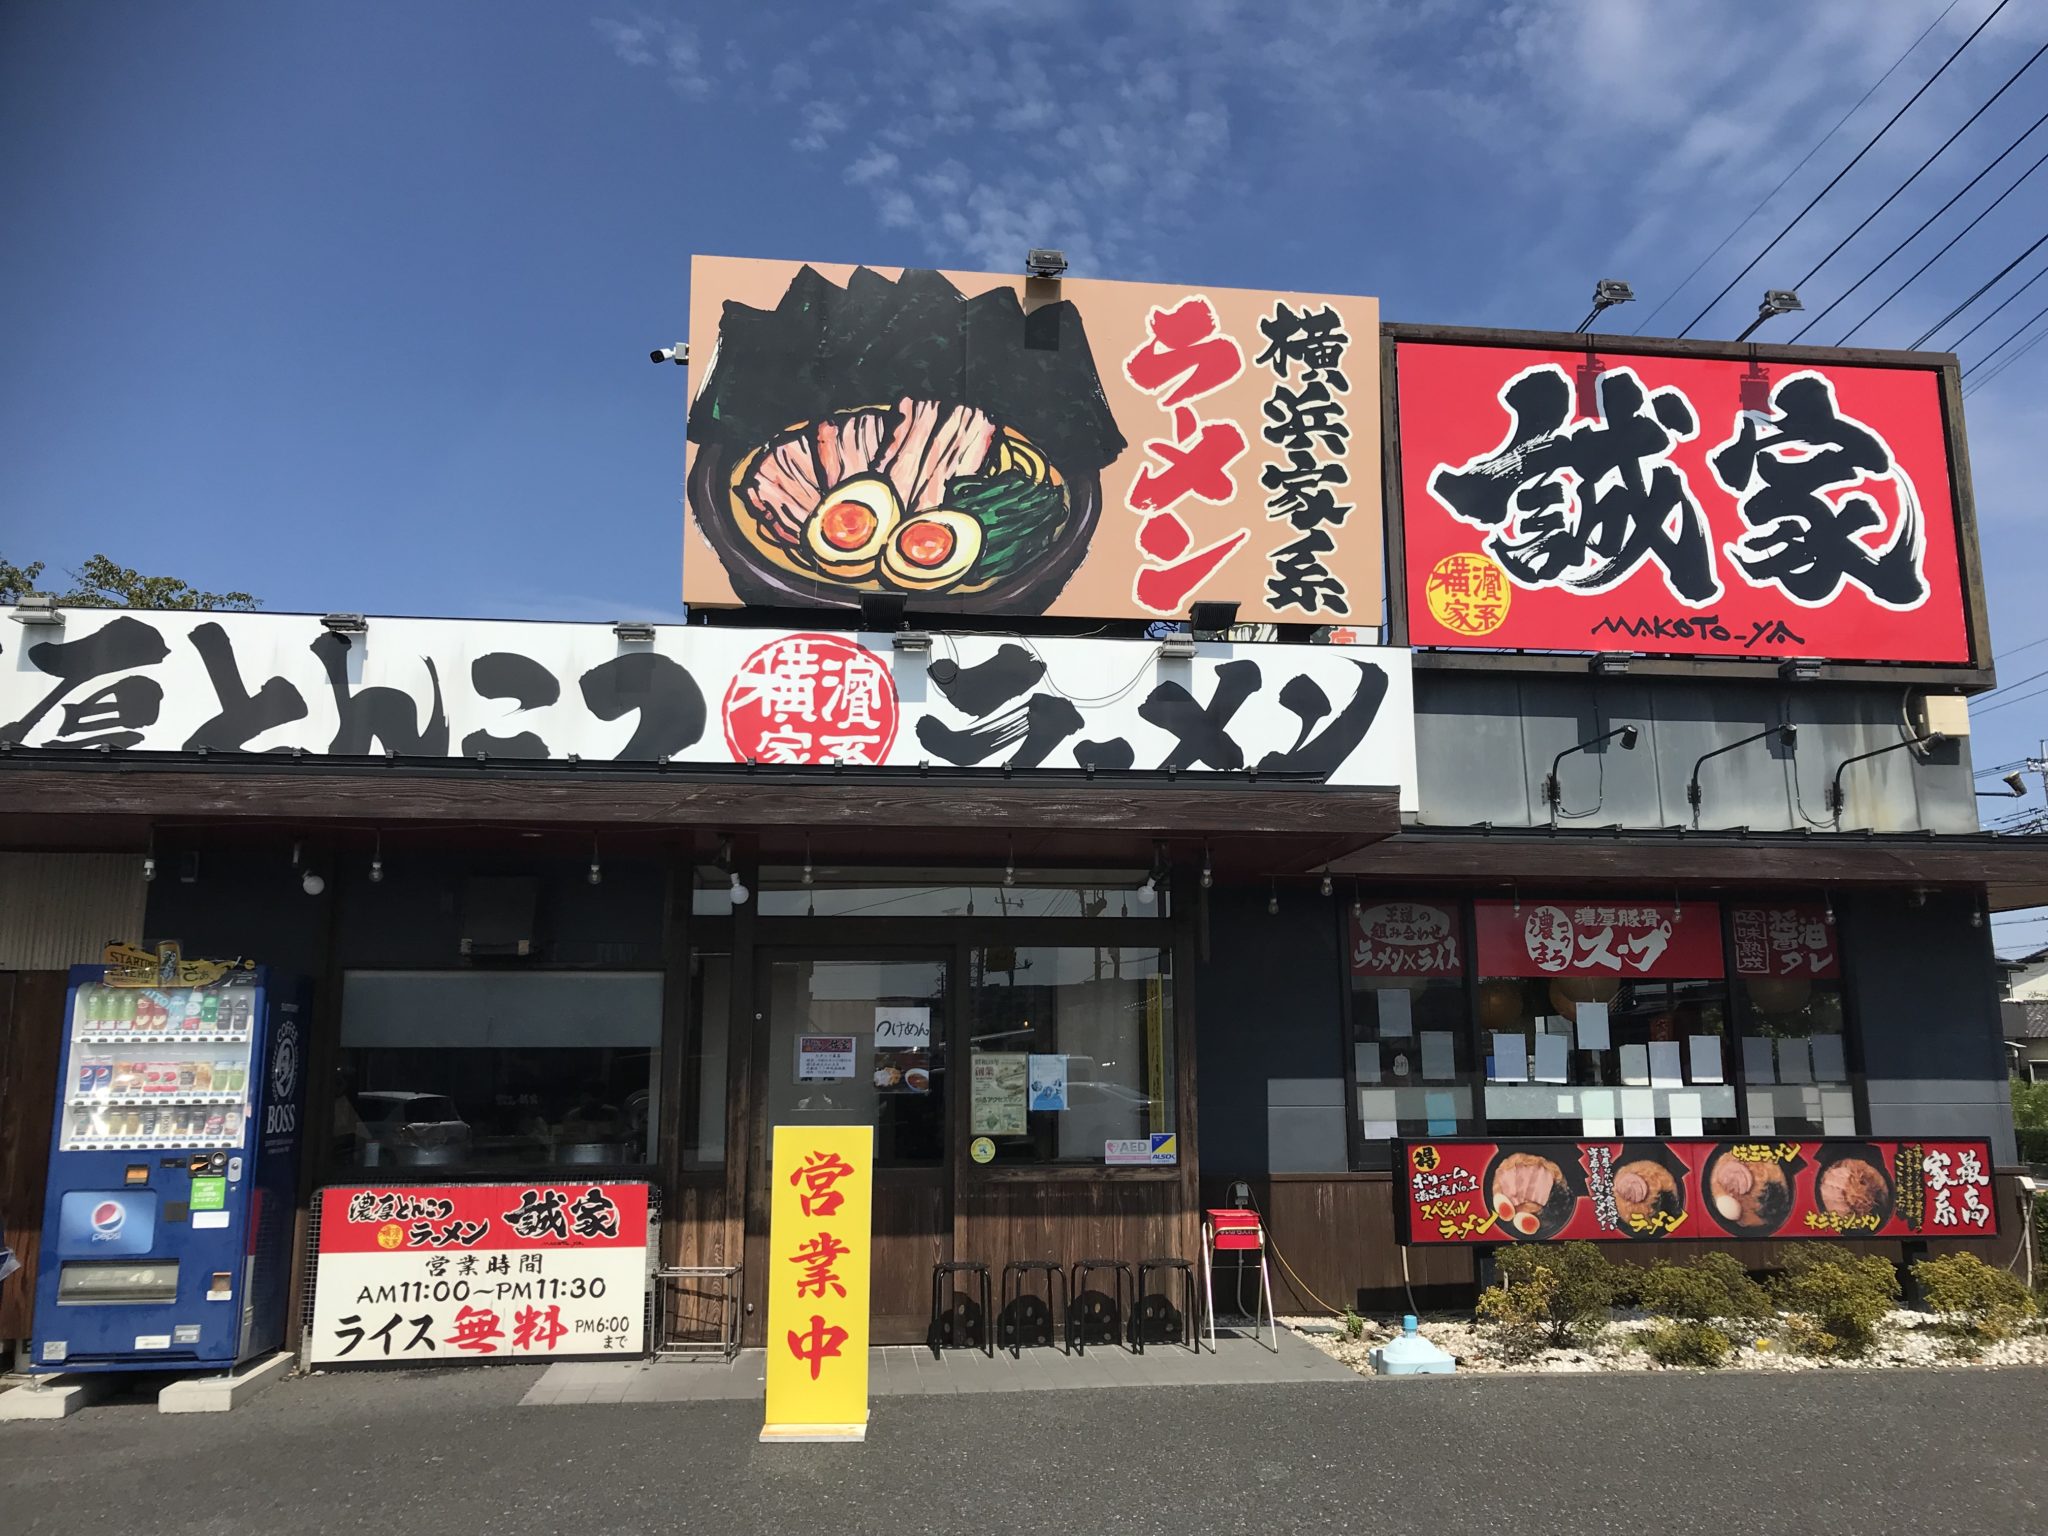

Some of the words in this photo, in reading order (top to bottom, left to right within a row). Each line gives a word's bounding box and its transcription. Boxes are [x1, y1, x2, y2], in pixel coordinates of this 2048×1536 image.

[1126, 297, 1249, 613] ラーメン
[1256, 302, 1354, 613] 横浜家系
[1430, 366, 1929, 606] 誠家
[1430, 556, 1502, 601] 横濱
[1442, 599, 1502, 631] 家系
[727, 642, 883, 724] 横濱
[915, 642, 1389, 784] ラーメン
[1574, 906, 1661, 928] 濃厚豚骨
[1573, 919, 1673, 973] スープ
[1736, 911, 1767, 970] 吟味熟成
[877, 1020, 930, 1038] つけめん
[266, 1104, 296, 1134] BOSS
[1120, 1142, 1147, 1152] AED
[1413, 1146, 1438, 1170] 得
[1732, 1142, 1802, 1165] 味玉ラーメン
[1412, 1166, 1469, 1190] ボリューム
[1922, 1149, 1959, 1227] 家系
[1956, 1149, 1990, 1228] 最高
[349, 1191, 454, 1222] 濃厚とんこつ
[503, 1187, 620, 1239] 誠家
[1420, 1199, 1471, 1221] スペシャル
[1629, 1208, 1690, 1236] ラーメン
[92, 1232, 121, 1242] pepsi
[407, 1219, 489, 1247] ラーメン
[1439, 1209, 1500, 1240] ラーメン
[425, 1254, 543, 1277] 営業時間
[787, 1150, 855, 1381] 営業中
[575, 1316, 630, 1334] PM6:00
[603, 1334, 627, 1350] まで
